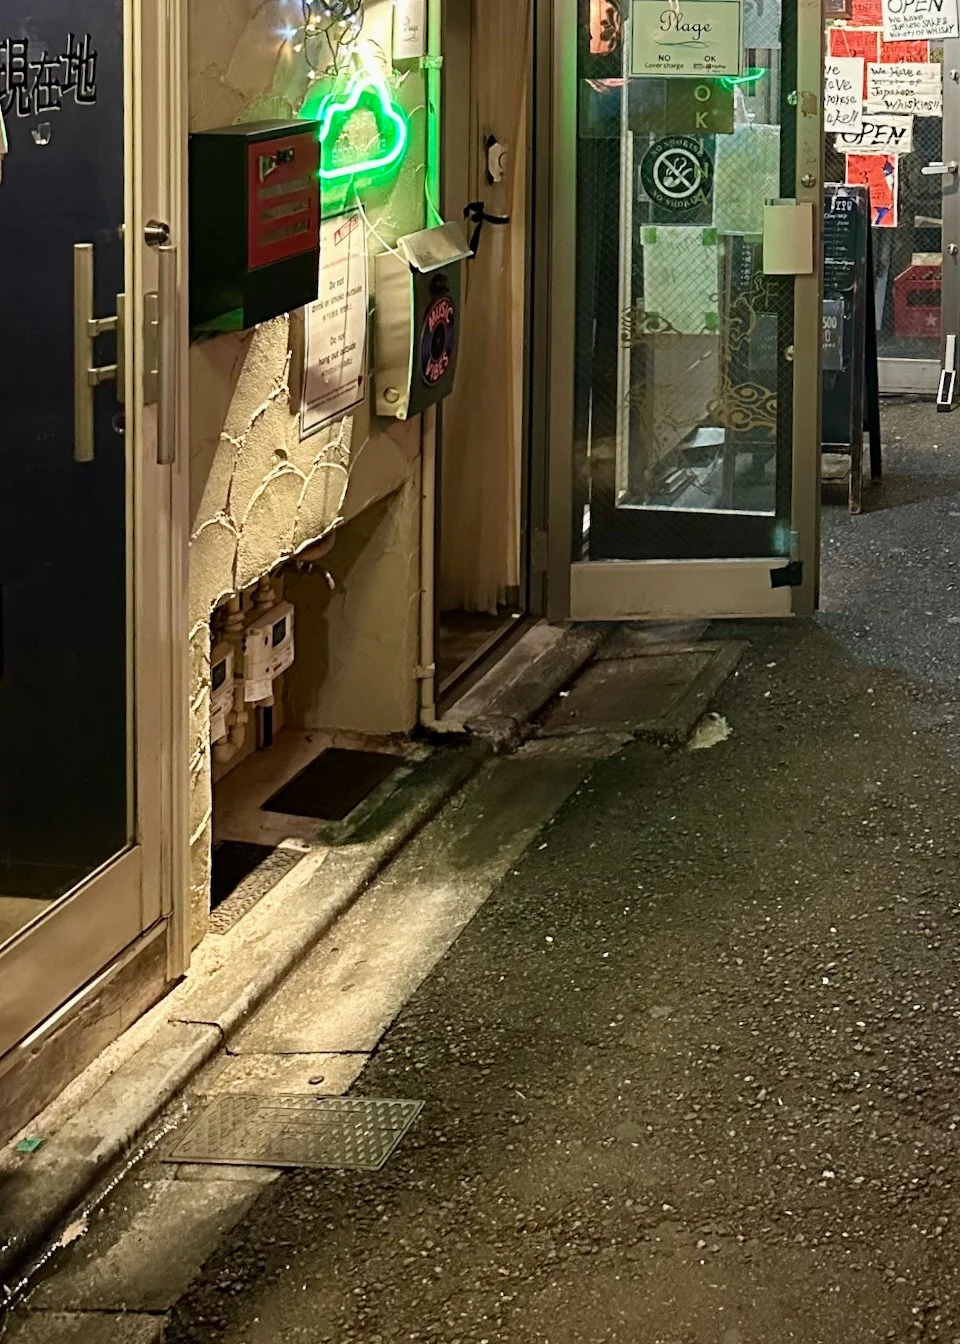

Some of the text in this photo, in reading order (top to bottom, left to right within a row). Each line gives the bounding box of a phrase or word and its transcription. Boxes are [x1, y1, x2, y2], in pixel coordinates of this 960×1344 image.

[660, 9, 712, 40] Plage
[663, 62, 684, 71] charge
[826, 78, 852, 91] ave
[827, 109, 859, 126] ake!!
[428, 301, 453, 332] MUSIC
